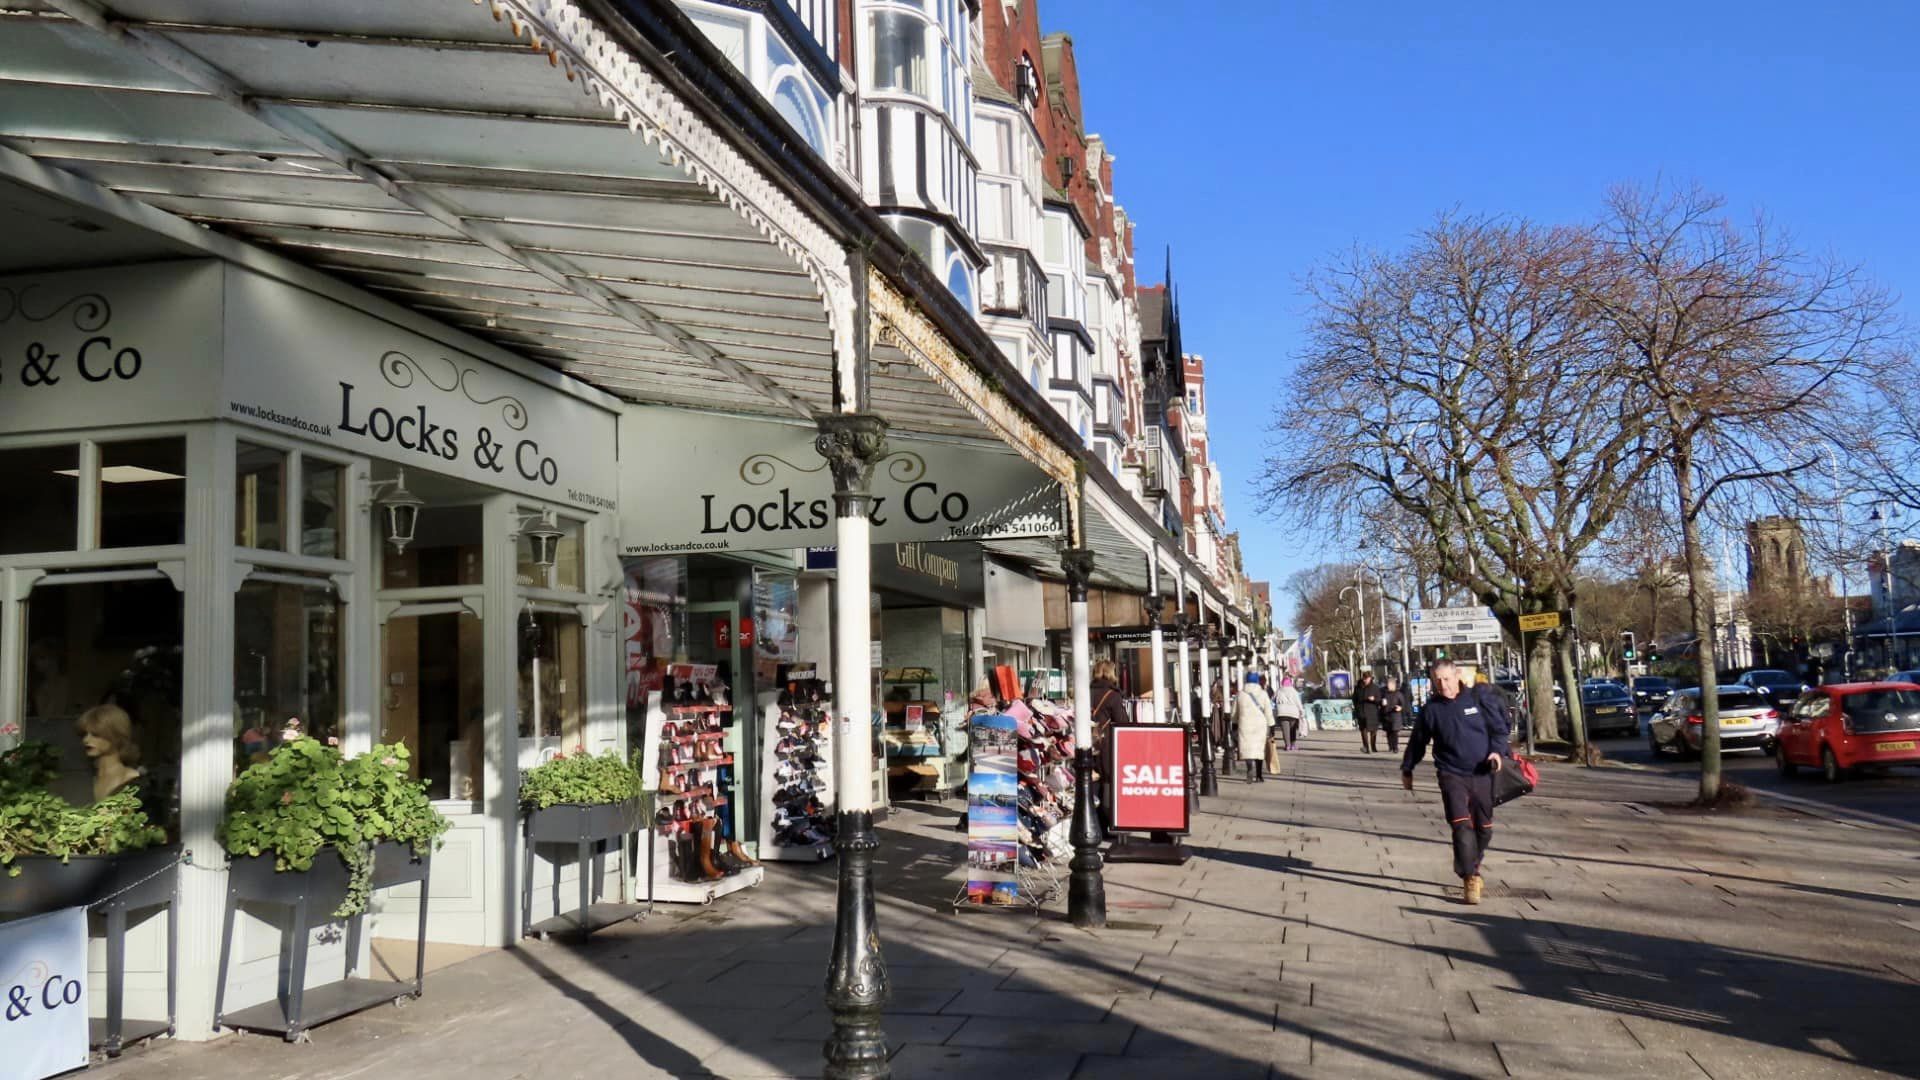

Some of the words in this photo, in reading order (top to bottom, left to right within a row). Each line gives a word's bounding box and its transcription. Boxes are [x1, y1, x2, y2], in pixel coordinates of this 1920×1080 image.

[20, 341, 60, 387] &
[77, 336, 142, 382] Co
[230, 401, 331, 436] www.locksandco.co.uk
[338, 381, 458, 461] Locks
[473, 426, 504, 473] &
[515, 439, 558, 485] Co
[701, 488, 828, 533] Locks
[904, 482, 969, 523] Co
[625, 539, 729, 553] www.locksandco.co.uk
[949, 525, 969, 536] Tel:
[972, 524, 1008, 536] 01704
[1012, 522, 1057, 534] 541060
[917, 541, 959, 590] Company
[1122, 764, 1183, 785] SALE
[1122, 786, 1159, 796] NOW
[1161, 786, 1184, 797] ON
[5, 985, 32, 1022] &
[42, 974, 82, 1010] Co
